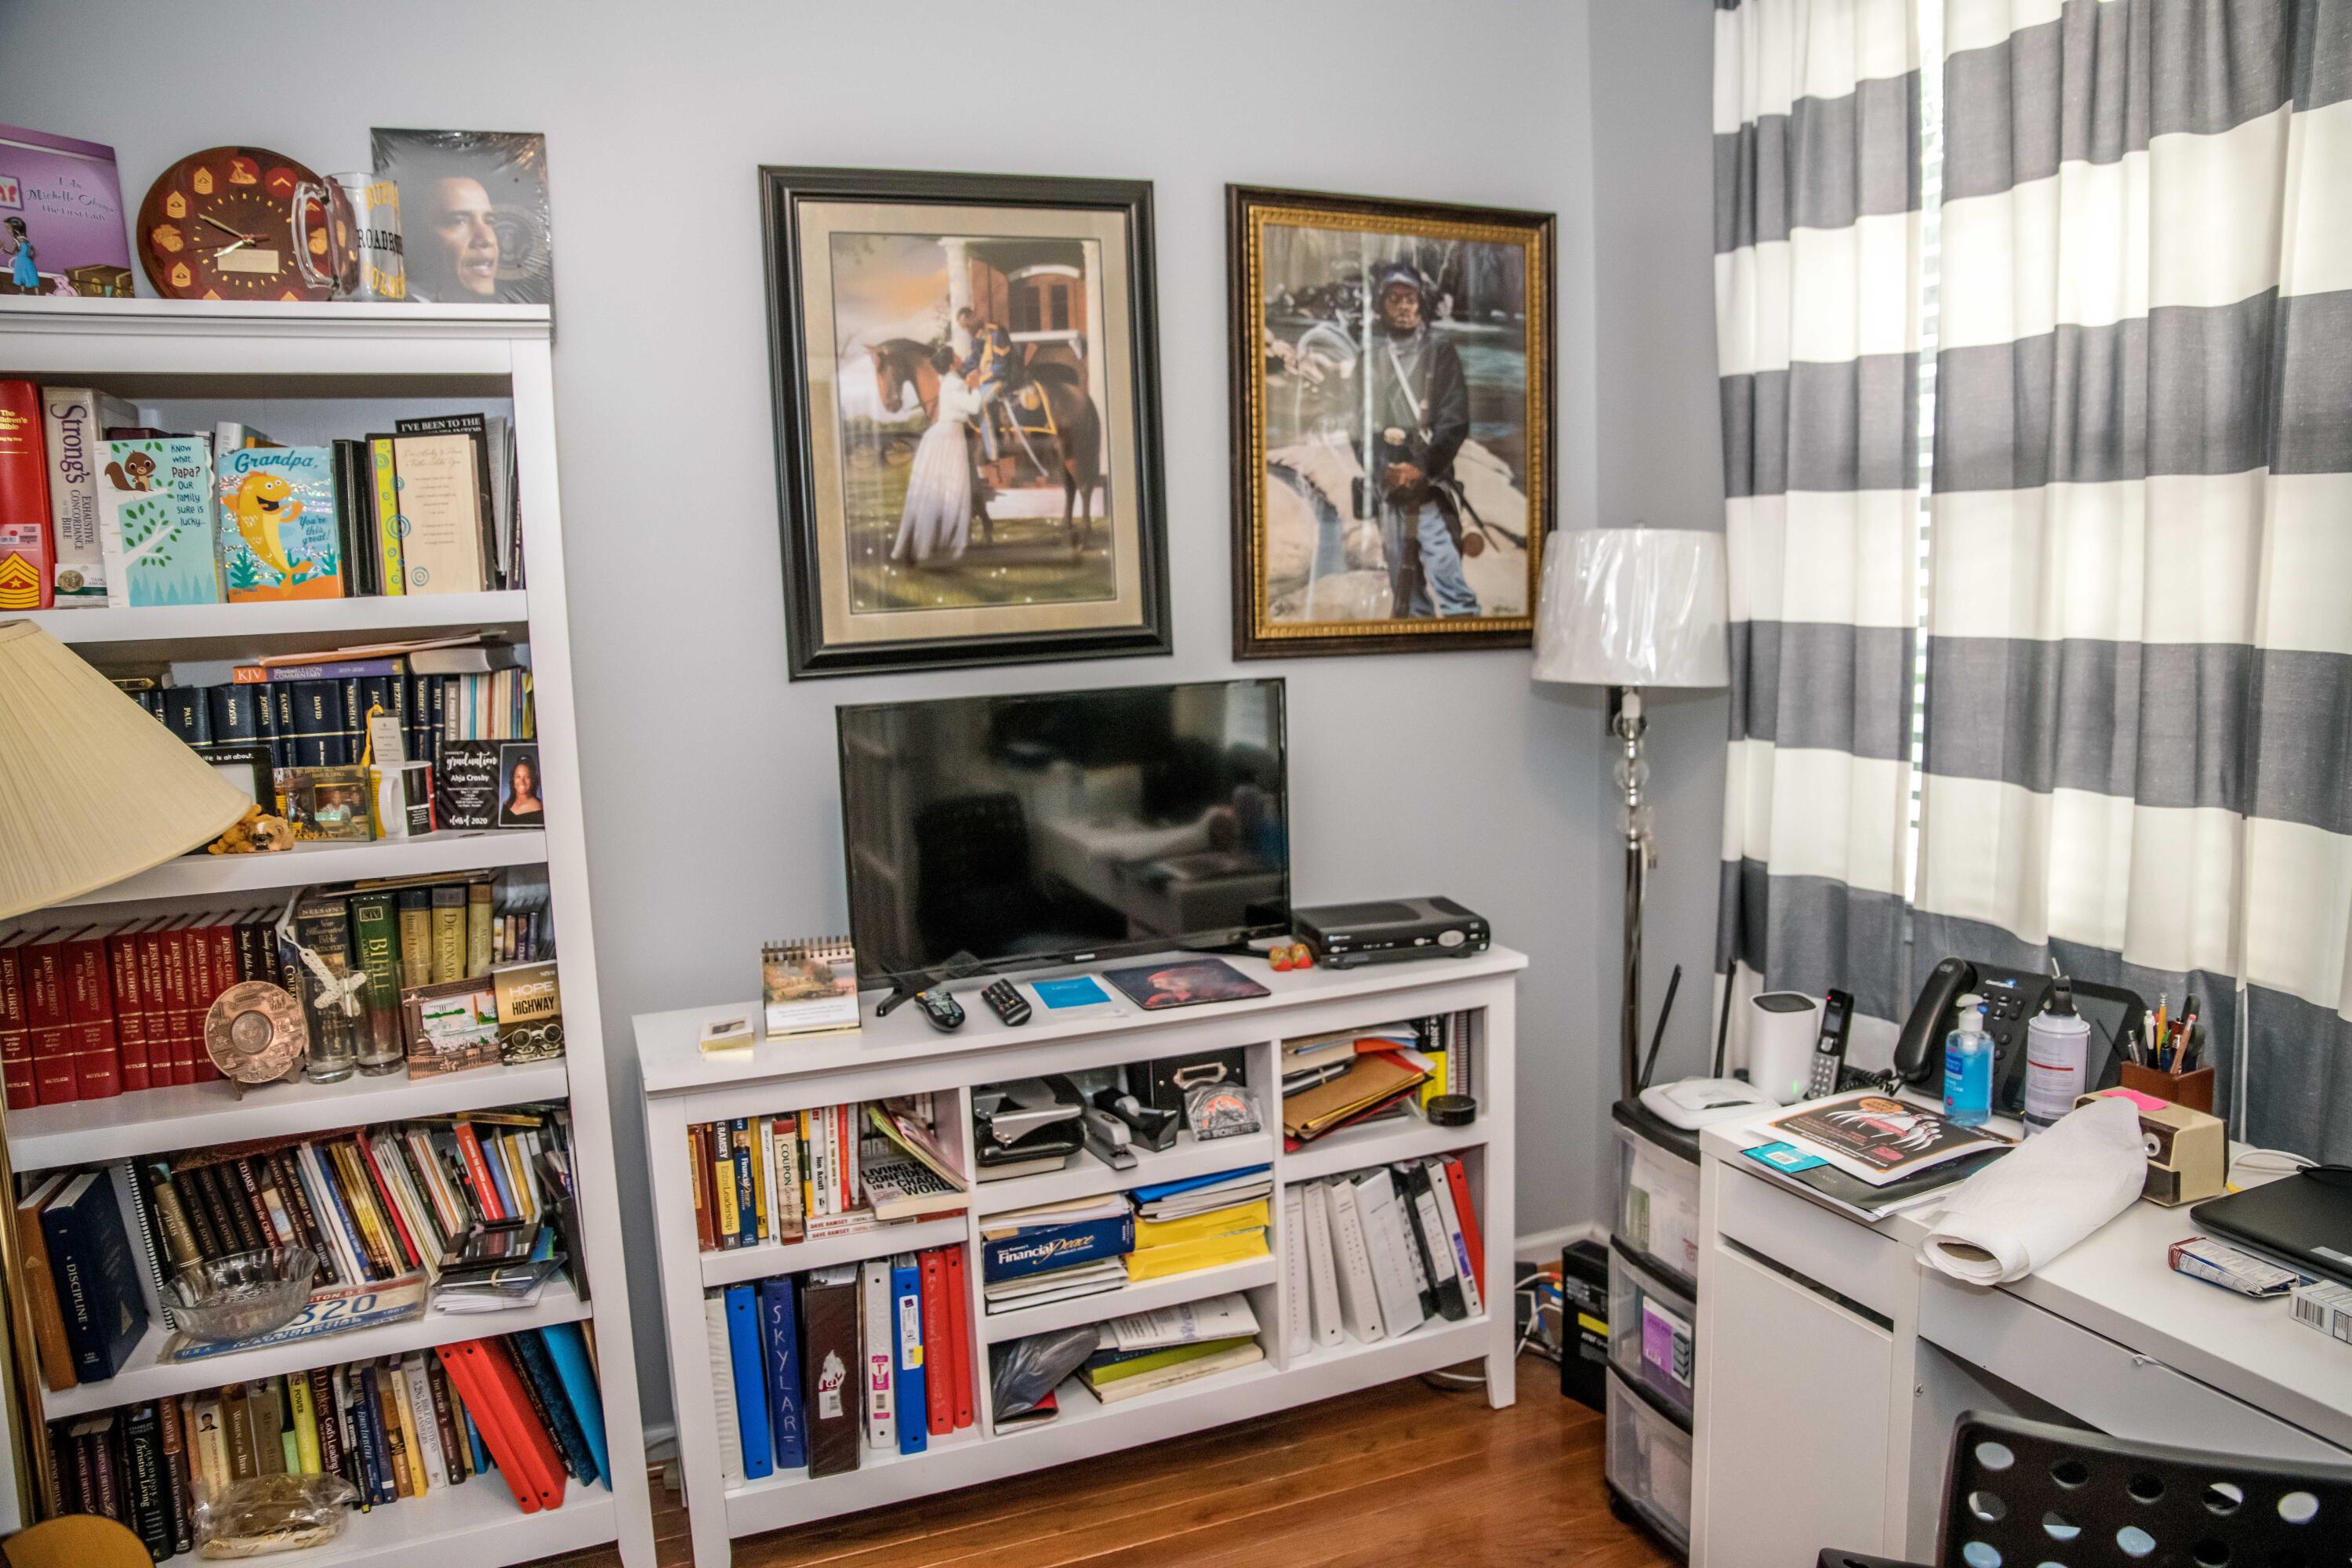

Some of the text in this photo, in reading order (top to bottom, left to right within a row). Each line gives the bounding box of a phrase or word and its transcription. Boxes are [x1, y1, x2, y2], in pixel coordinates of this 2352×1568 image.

[50, 403, 90, 485] Strong's
[422, 420, 446, 430] BEEN
[447, 419, 460, 428] TO
[462, 417, 481, 426] THE
[62, 517, 72, 539] BIBLE
[71, 489, 83, 550] CONCORDANCE
[82, 495, 94, 544] EXHAUSTIVE
[238, 668, 262, 681] KJV
[183, 707, 192, 728] PAUL
[260, 695, 270, 725] JOSHUA
[280, 693, 289, 724] SAMUEL
[314, 695, 322, 720] DAVID
[196, 938, 210, 998] JESUS CHRIST
[445, 913, 459, 980] DICTIONARY
[3, 959, 19, 1021] JESUS CHRIST
[43, 956, 58, 1017] JESUS CHRIST
[84, 951, 100, 1011] JESUS CHRIST
[123, 943, 137, 1004] JESUS CHRIST
[148, 942, 163, 1003] JESUS CHRIST
[171, 941, 185, 1002] JESUS CHRIST
[510, 981, 555, 997] HOPE
[512, 996, 555, 1016] HIGHWAY
[717, 1127, 728, 1159] RAMSEY
[781, 1142, 792, 1189] COUPON
[862, 1164, 909, 1178] LIVING
[867, 1169, 935, 1185] CONFIDEN
[902, 1184, 954, 1196] WORL
[998, 1244, 1054, 1265] Financial
[66, 1264, 88, 1323] DISCIPLINE
[78, 1447, 90, 1506] PURPOSE DRIVEN
[97, 1445, 111, 1503] PURPOSE DRIVEN
[135, 1438, 150, 1508] Christian Living
[328, 1441, 340, 1472] Leading
